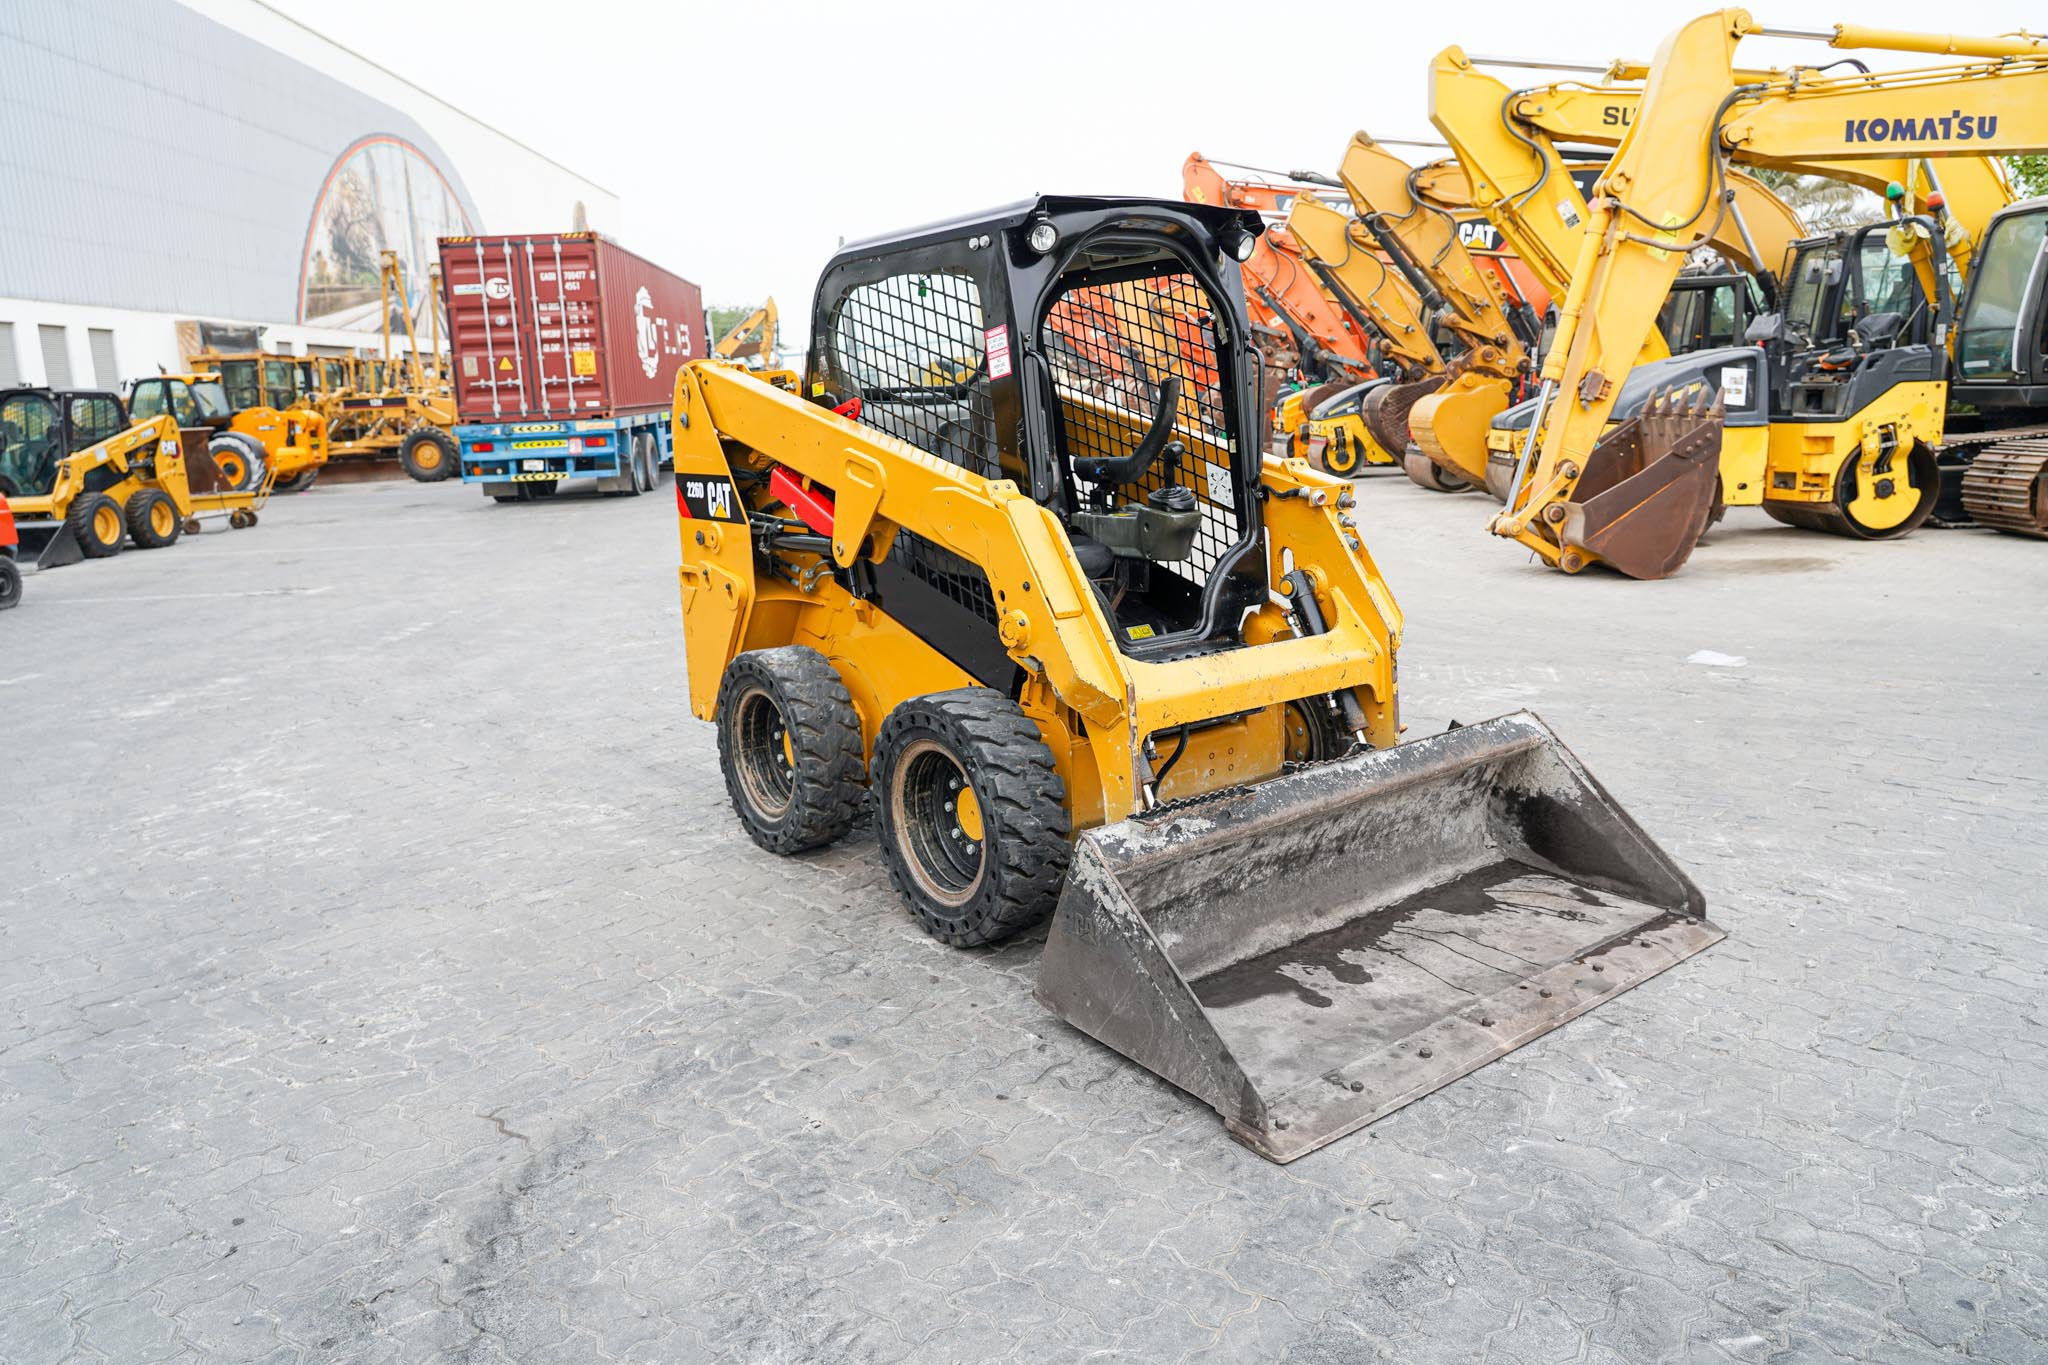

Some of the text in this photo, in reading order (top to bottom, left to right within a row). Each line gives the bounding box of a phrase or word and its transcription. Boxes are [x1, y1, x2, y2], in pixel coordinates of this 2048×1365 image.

[1845, 110, 1998, 143] KOMATSU
[1459, 222, 1497, 249] CAT
[686, 480, 731, 519] 226D CAT
